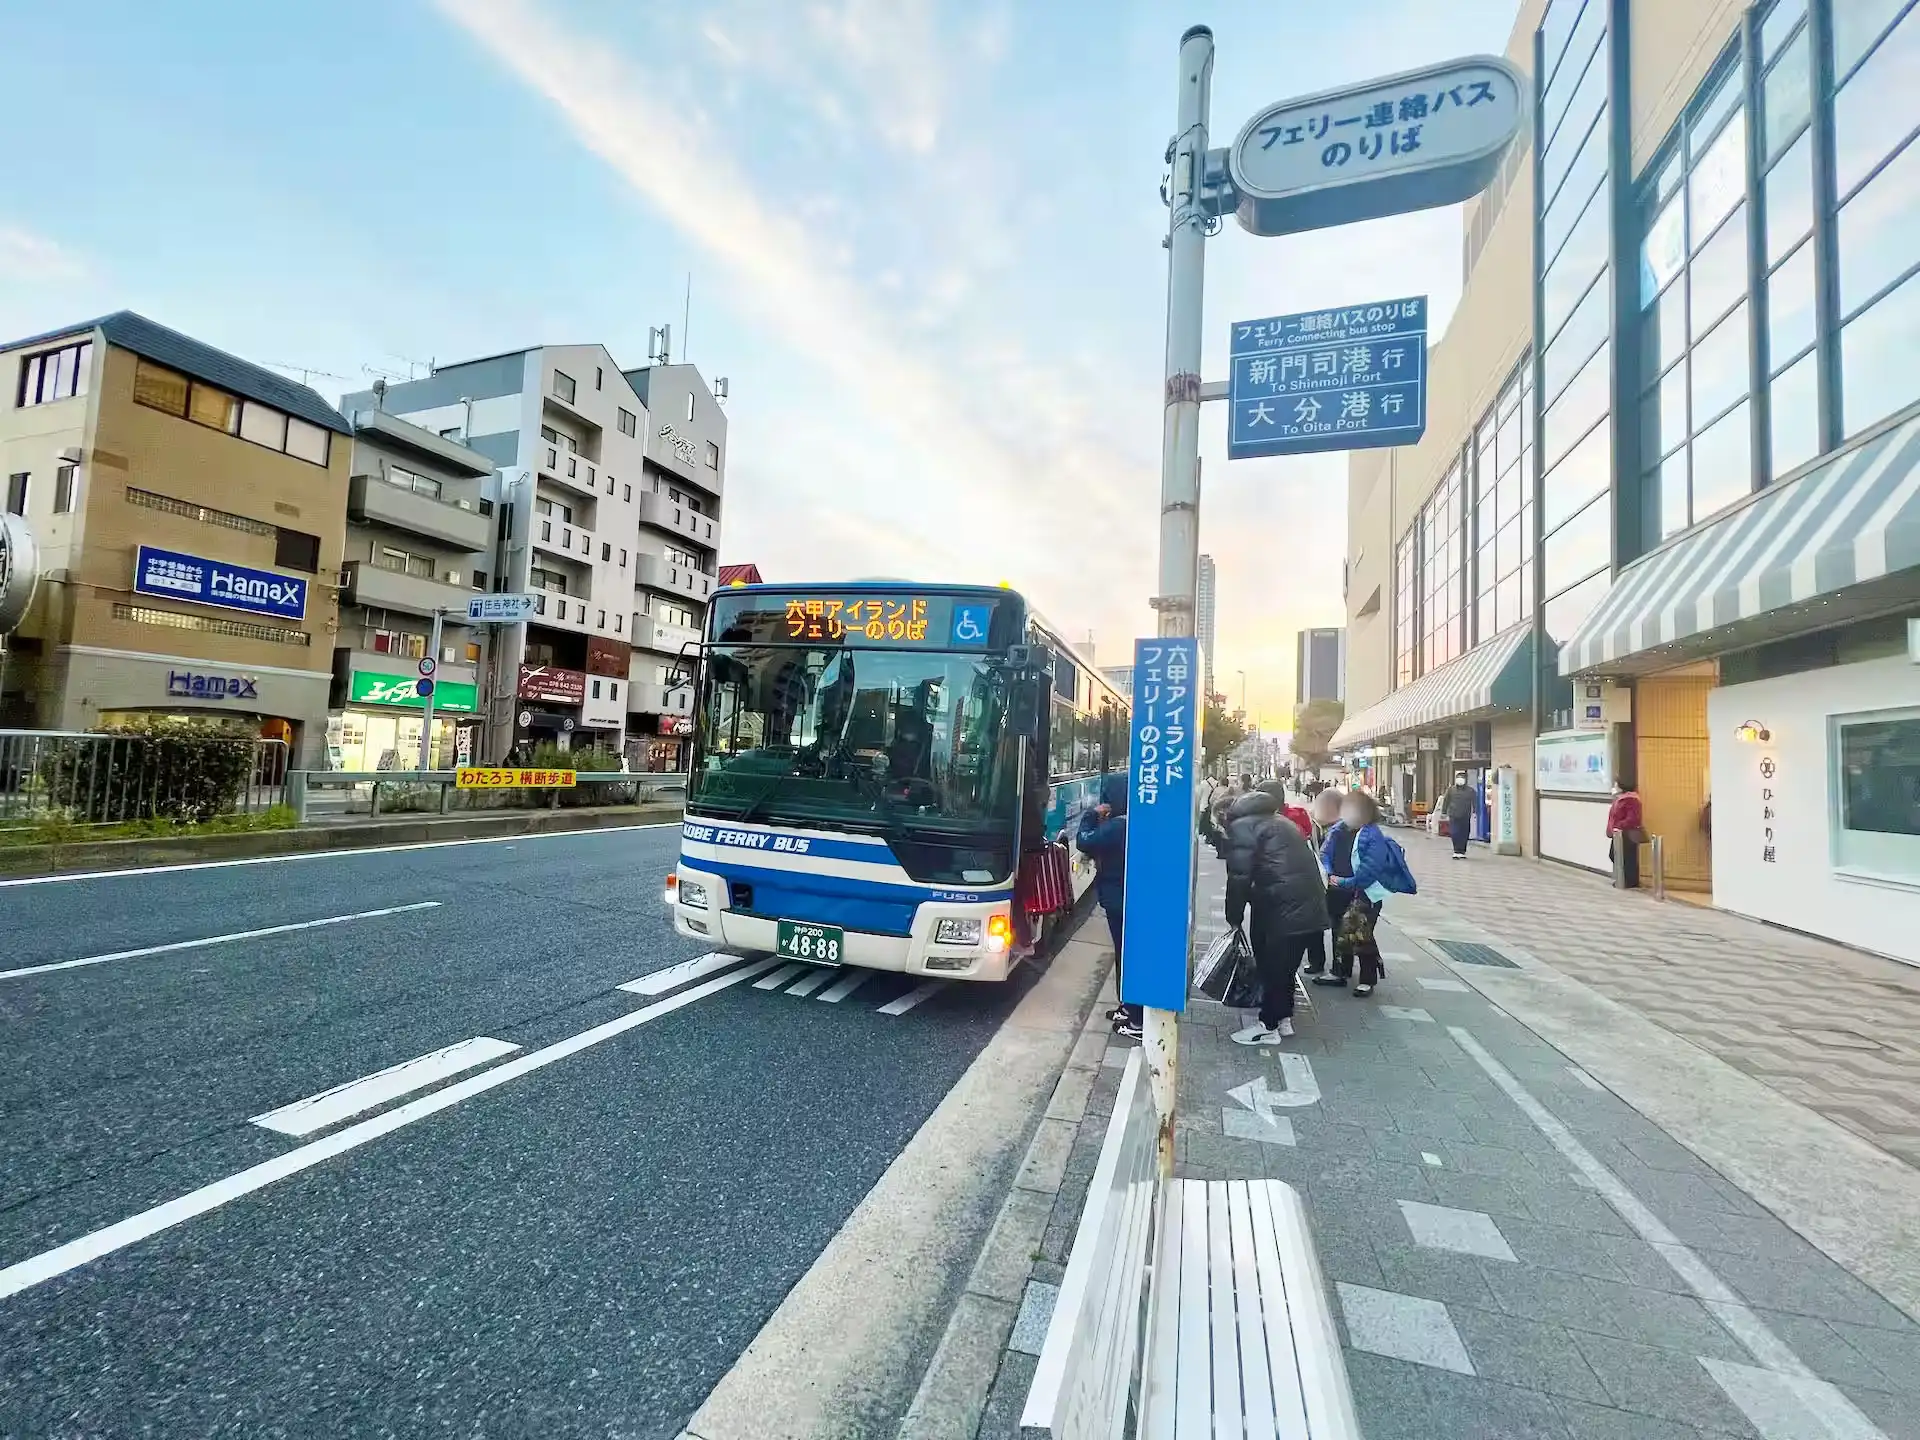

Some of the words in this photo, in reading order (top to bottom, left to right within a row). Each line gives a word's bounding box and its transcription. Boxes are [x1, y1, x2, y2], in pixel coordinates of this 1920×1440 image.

[1258, 80, 1496, 152] フェリー連絡バス
[1320, 123, 1424, 168] のりば
[1238, 300, 1420, 341] フェリー連絡バスのりば
[1258, 337, 1284, 348] Ferry
[1287, 328, 1347, 344] Connecting
[1349, 324, 1368, 336] bus
[1371, 322, 1396, 334] stop
[1249, 346, 1372, 385] 新門司港
[1381, 348, 1405, 370] 行
[1270, 382, 1286, 393] To
[1290, 374, 1348, 391] Shinmoji
[1352, 371, 1381, 384] Port
[1380, 393, 1405, 416] 行
[1281, 424, 1299, 435] To
[1303, 421, 1332, 433] Oita
[1336, 417, 1368, 430] Port
[785, 600, 928, 621] 六甲アイランド
[787, 619, 929, 641] フェリーのりば
[1137, 647, 1163, 805] フェリーのりば行
[1164, 644, 1189, 786] 六甲アイランド
[460, 770, 514, 785] わたろう
[520, 770, 574, 785] 横断歩道
[683, 822, 714, 841] KOBE
[715, 829, 771, 848] FERRY
[772, 836, 811, 853] BUS
[1763, 787, 1776, 863] ひかり屋
[932, 890, 979, 902] FUSO
[789, 934, 839, 961] 48-88
